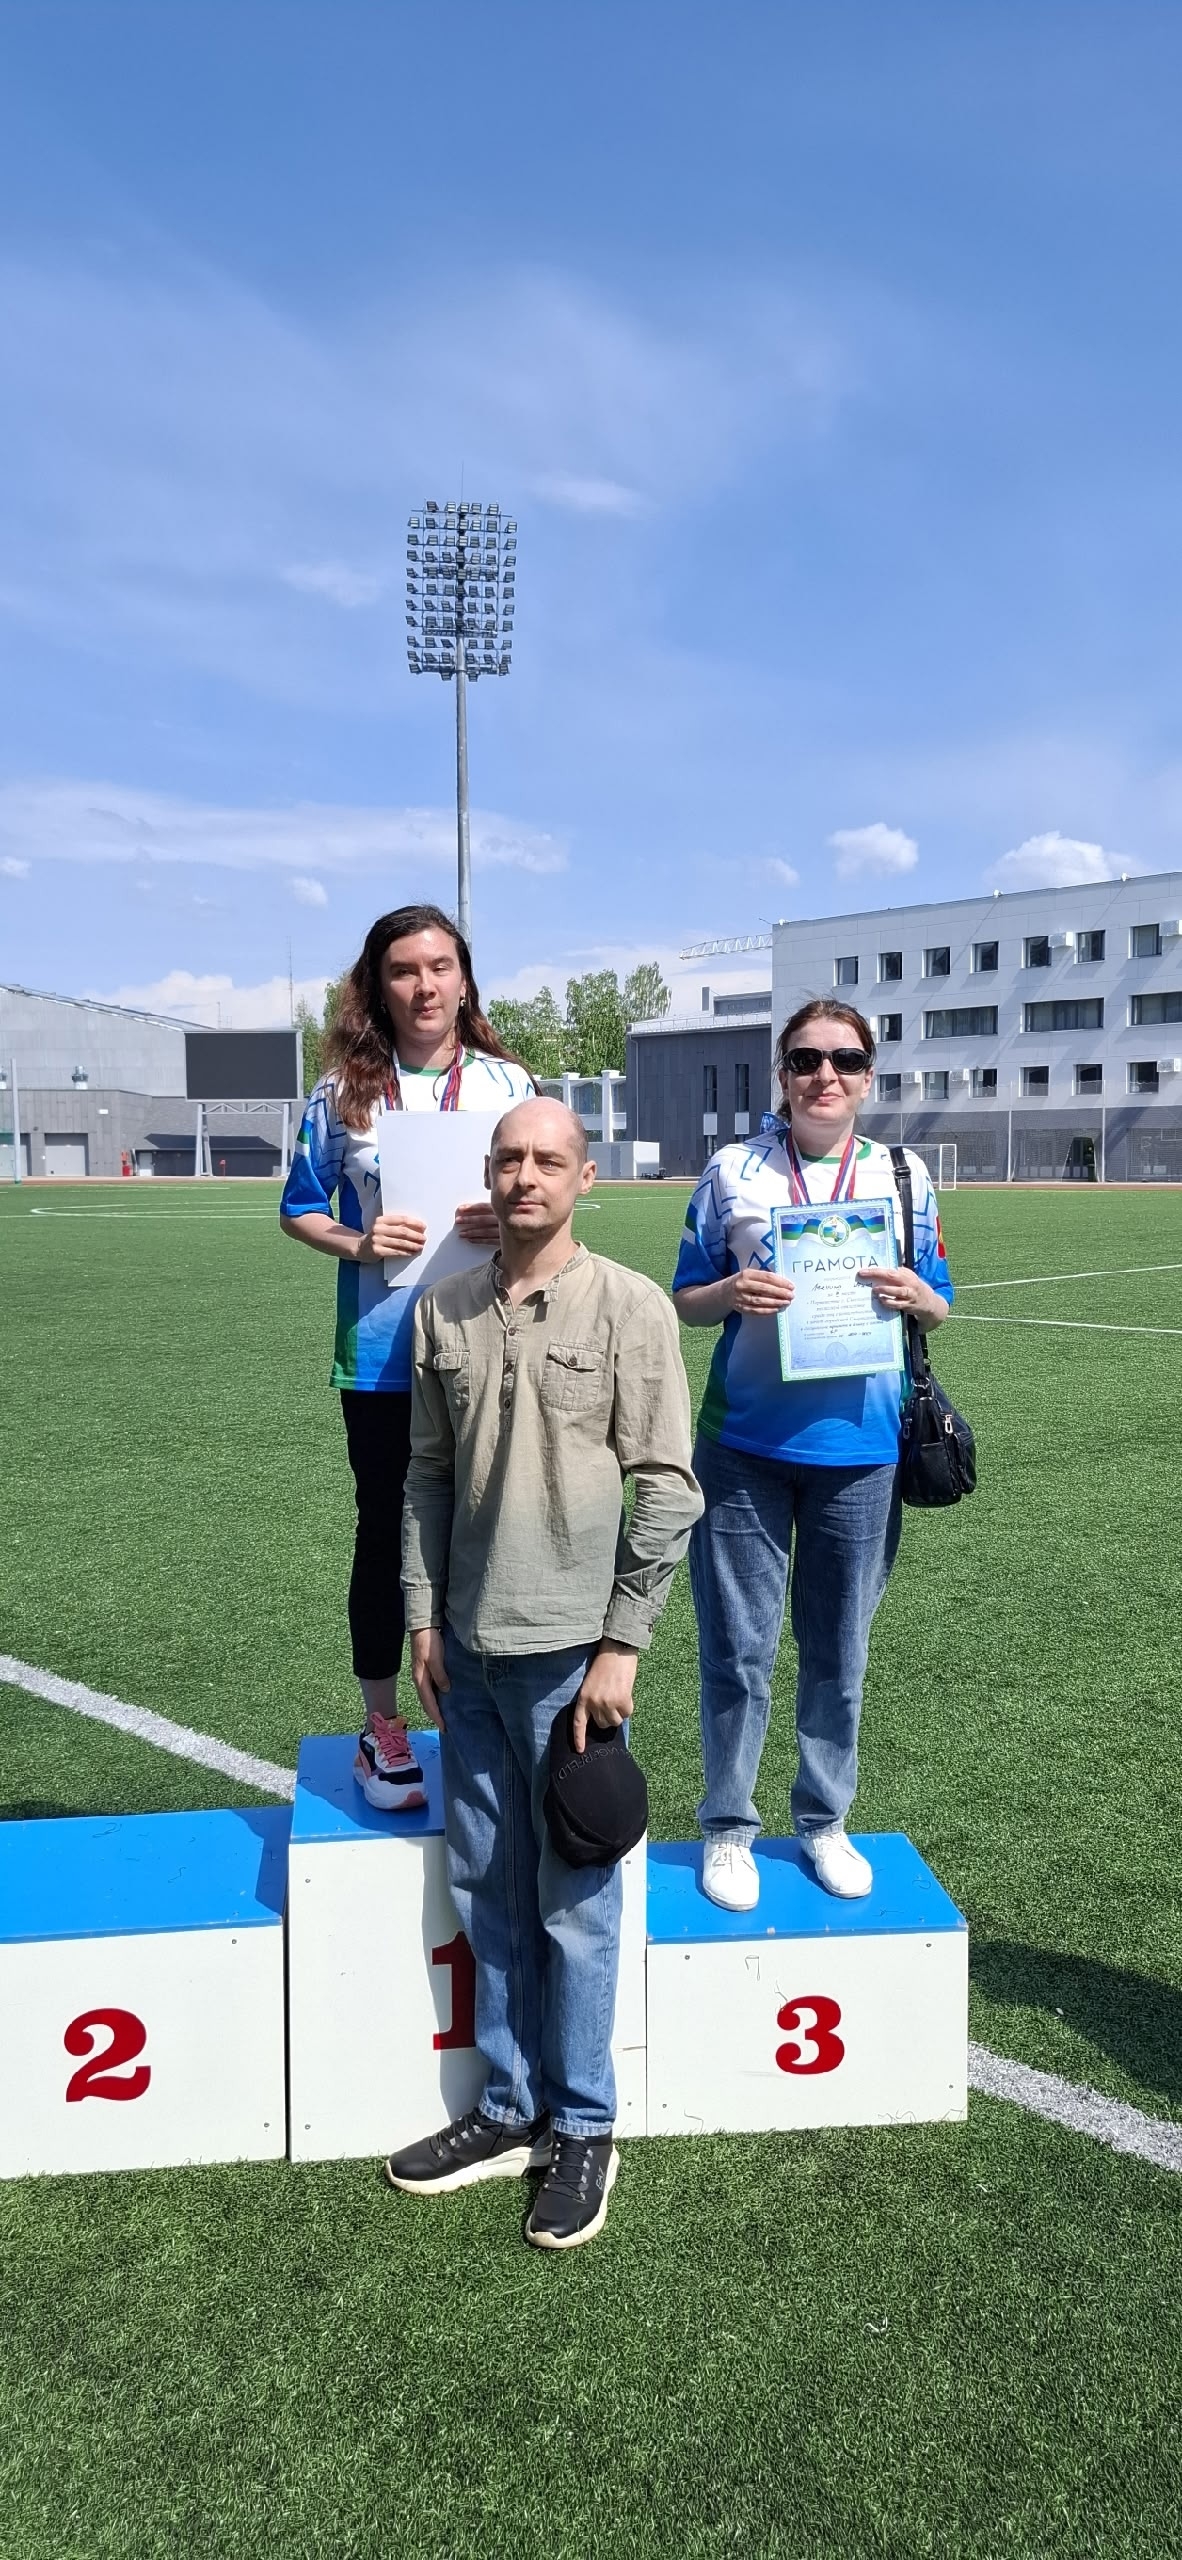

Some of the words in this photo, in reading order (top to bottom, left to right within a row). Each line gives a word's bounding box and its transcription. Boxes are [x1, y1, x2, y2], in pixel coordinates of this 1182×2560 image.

[792, 1256, 879, 1273] ГРАМОТА
[432, 1930, 476, 2050] 1
[64, 2008, 151, 2102] 2
[775, 1995, 845, 2075] 3
[595, 2164, 606, 2191] EA7
